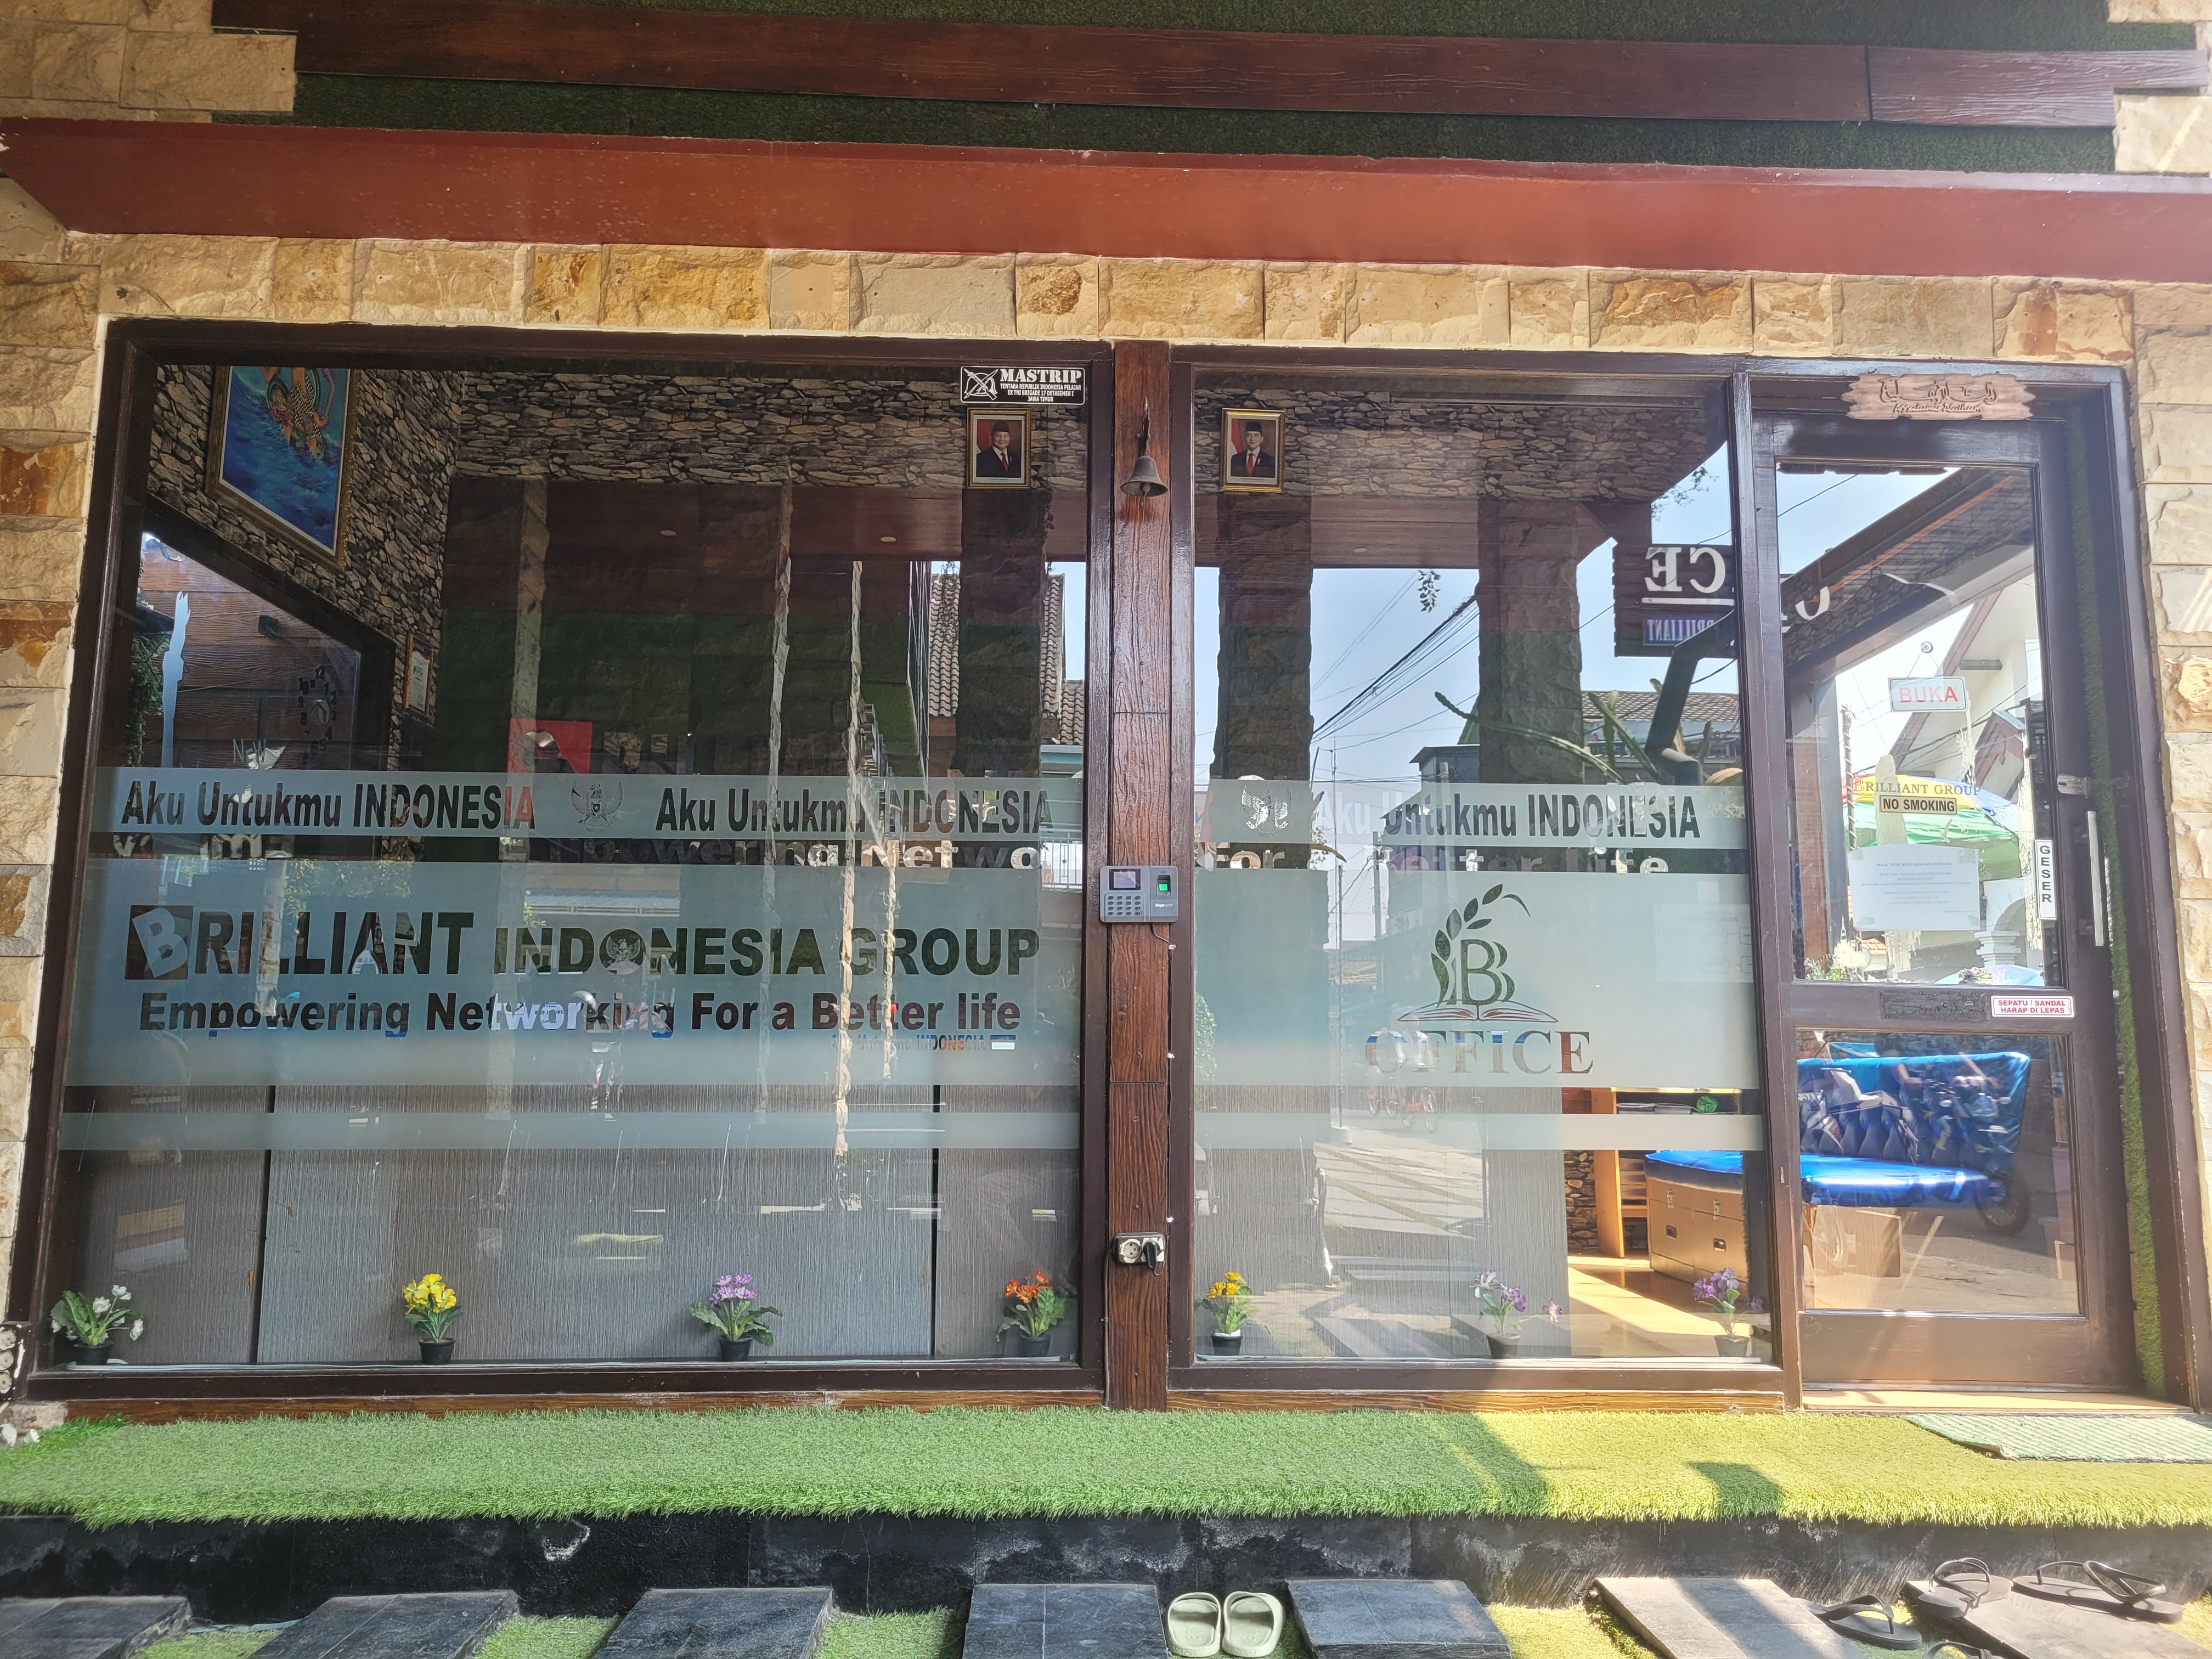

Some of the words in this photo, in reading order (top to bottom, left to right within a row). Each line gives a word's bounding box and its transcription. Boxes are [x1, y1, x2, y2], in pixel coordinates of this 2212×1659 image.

[1000, 369, 1081, 383] MASTRIP
[1899, 686, 1958, 703] BUKA
[121, 781, 184, 825] Aku
[197, 782, 342, 827] Untukmu
[353, 783, 535, 830] INDONESIA
[656, 787, 716, 832] Aku
[727, 788, 867, 832] Untukmu
[879, 789, 1053, 833] INDONESIA
[1883, 798, 1899, 810] NO
[1903, 799, 1955, 812] SMOKING
[1934, 785, 1981, 795] GROUP
[1319, 791, 1371, 834] Aku
[1382, 792, 1517, 837] Untukmu
[1528, 793, 1701, 839] INDONESIA
[2040, 845, 2052, 902] GESER
[125, 905, 474, 980] BRILLIANT
[494, 927, 826, 975] INDONESIA
[840, 927, 1039, 976] GROUP
[140, 992, 409, 1037] Empowering
[426, 992, 674, 1037] Networking
[691, 992, 758, 1030] For
[772, 1001, 795, 1030] a
[811, 992, 944, 1030] Better
[958, 992, 1021, 1030] life
[1365, 1030, 1593, 1074] OFFICE
